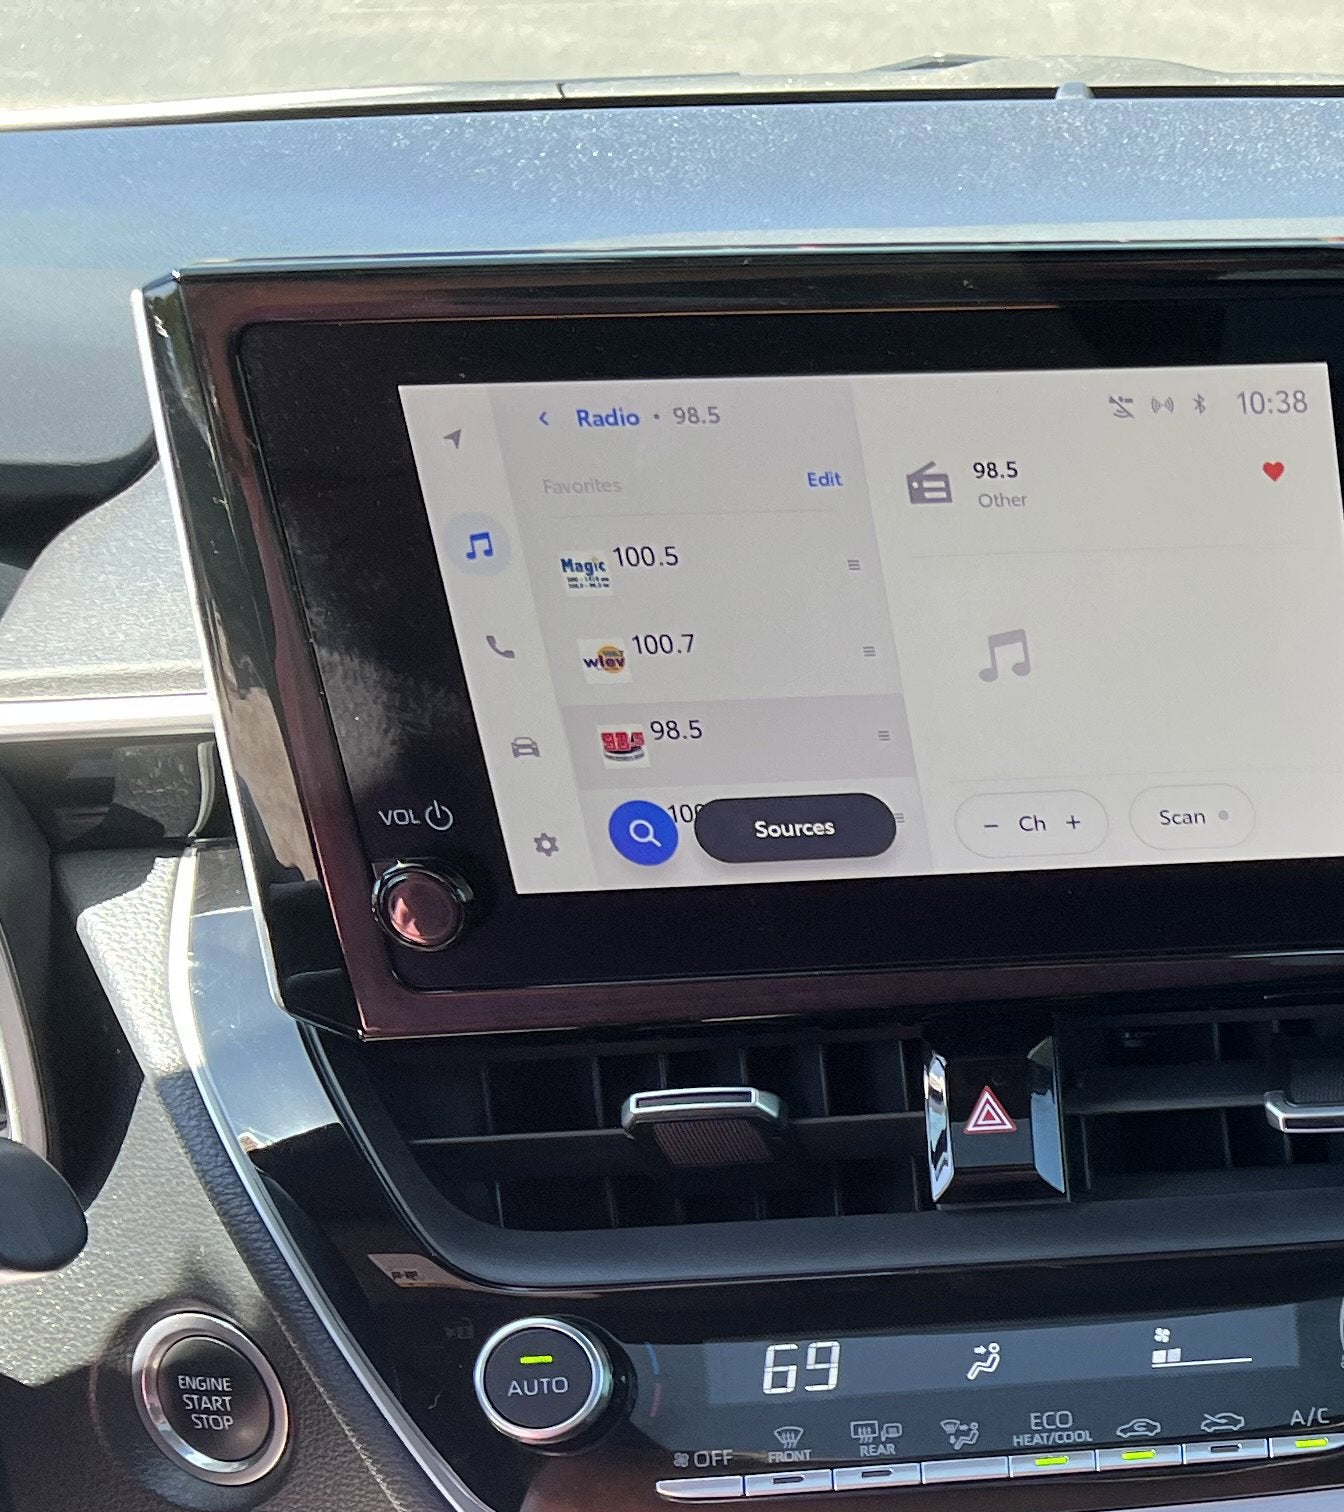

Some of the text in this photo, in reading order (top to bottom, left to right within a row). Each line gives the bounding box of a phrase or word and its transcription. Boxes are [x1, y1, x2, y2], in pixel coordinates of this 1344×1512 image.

[1236, 390, 1308, 415] 10:38
[576, 406, 721, 427] Radio 98.5
[807, 471, 843, 488] Edit
[972, 461, 1018, 480] 98.5
[543, 477, 622, 495] Favorites
[977, 491, 1029, 509] Other
[613, 546, 679, 567] 100.5
[561, 558, 606, 576] Magic
[632, 634, 694, 655] 100.7
[650, 719, 702, 740] 98.5
[379, 809, 421, 826] VOL
[1018, 815, 1047, 832] Ch
[1159, 809, 1206, 827] Scan
[754, 819, 836, 839] Sources
[762, 1340, 841, 1396] 69
[177, 1375, 233, 1392] ENGINE
[507, 1375, 569, 1397] AUTO
[182, 1394, 232, 1412] START
[191, 1414, 234, 1431] STOP
[1029, 1409, 1073, 1430] ECO
[1290, 1406, 1329, 1426] A/C
[1012, 1429, 1094, 1446] HEAT/COOL
[693, 1448, 733, 1469] OFF
[767, 1448, 812, 1464] FRONT
[858, 1441, 896, 1458] REAR
